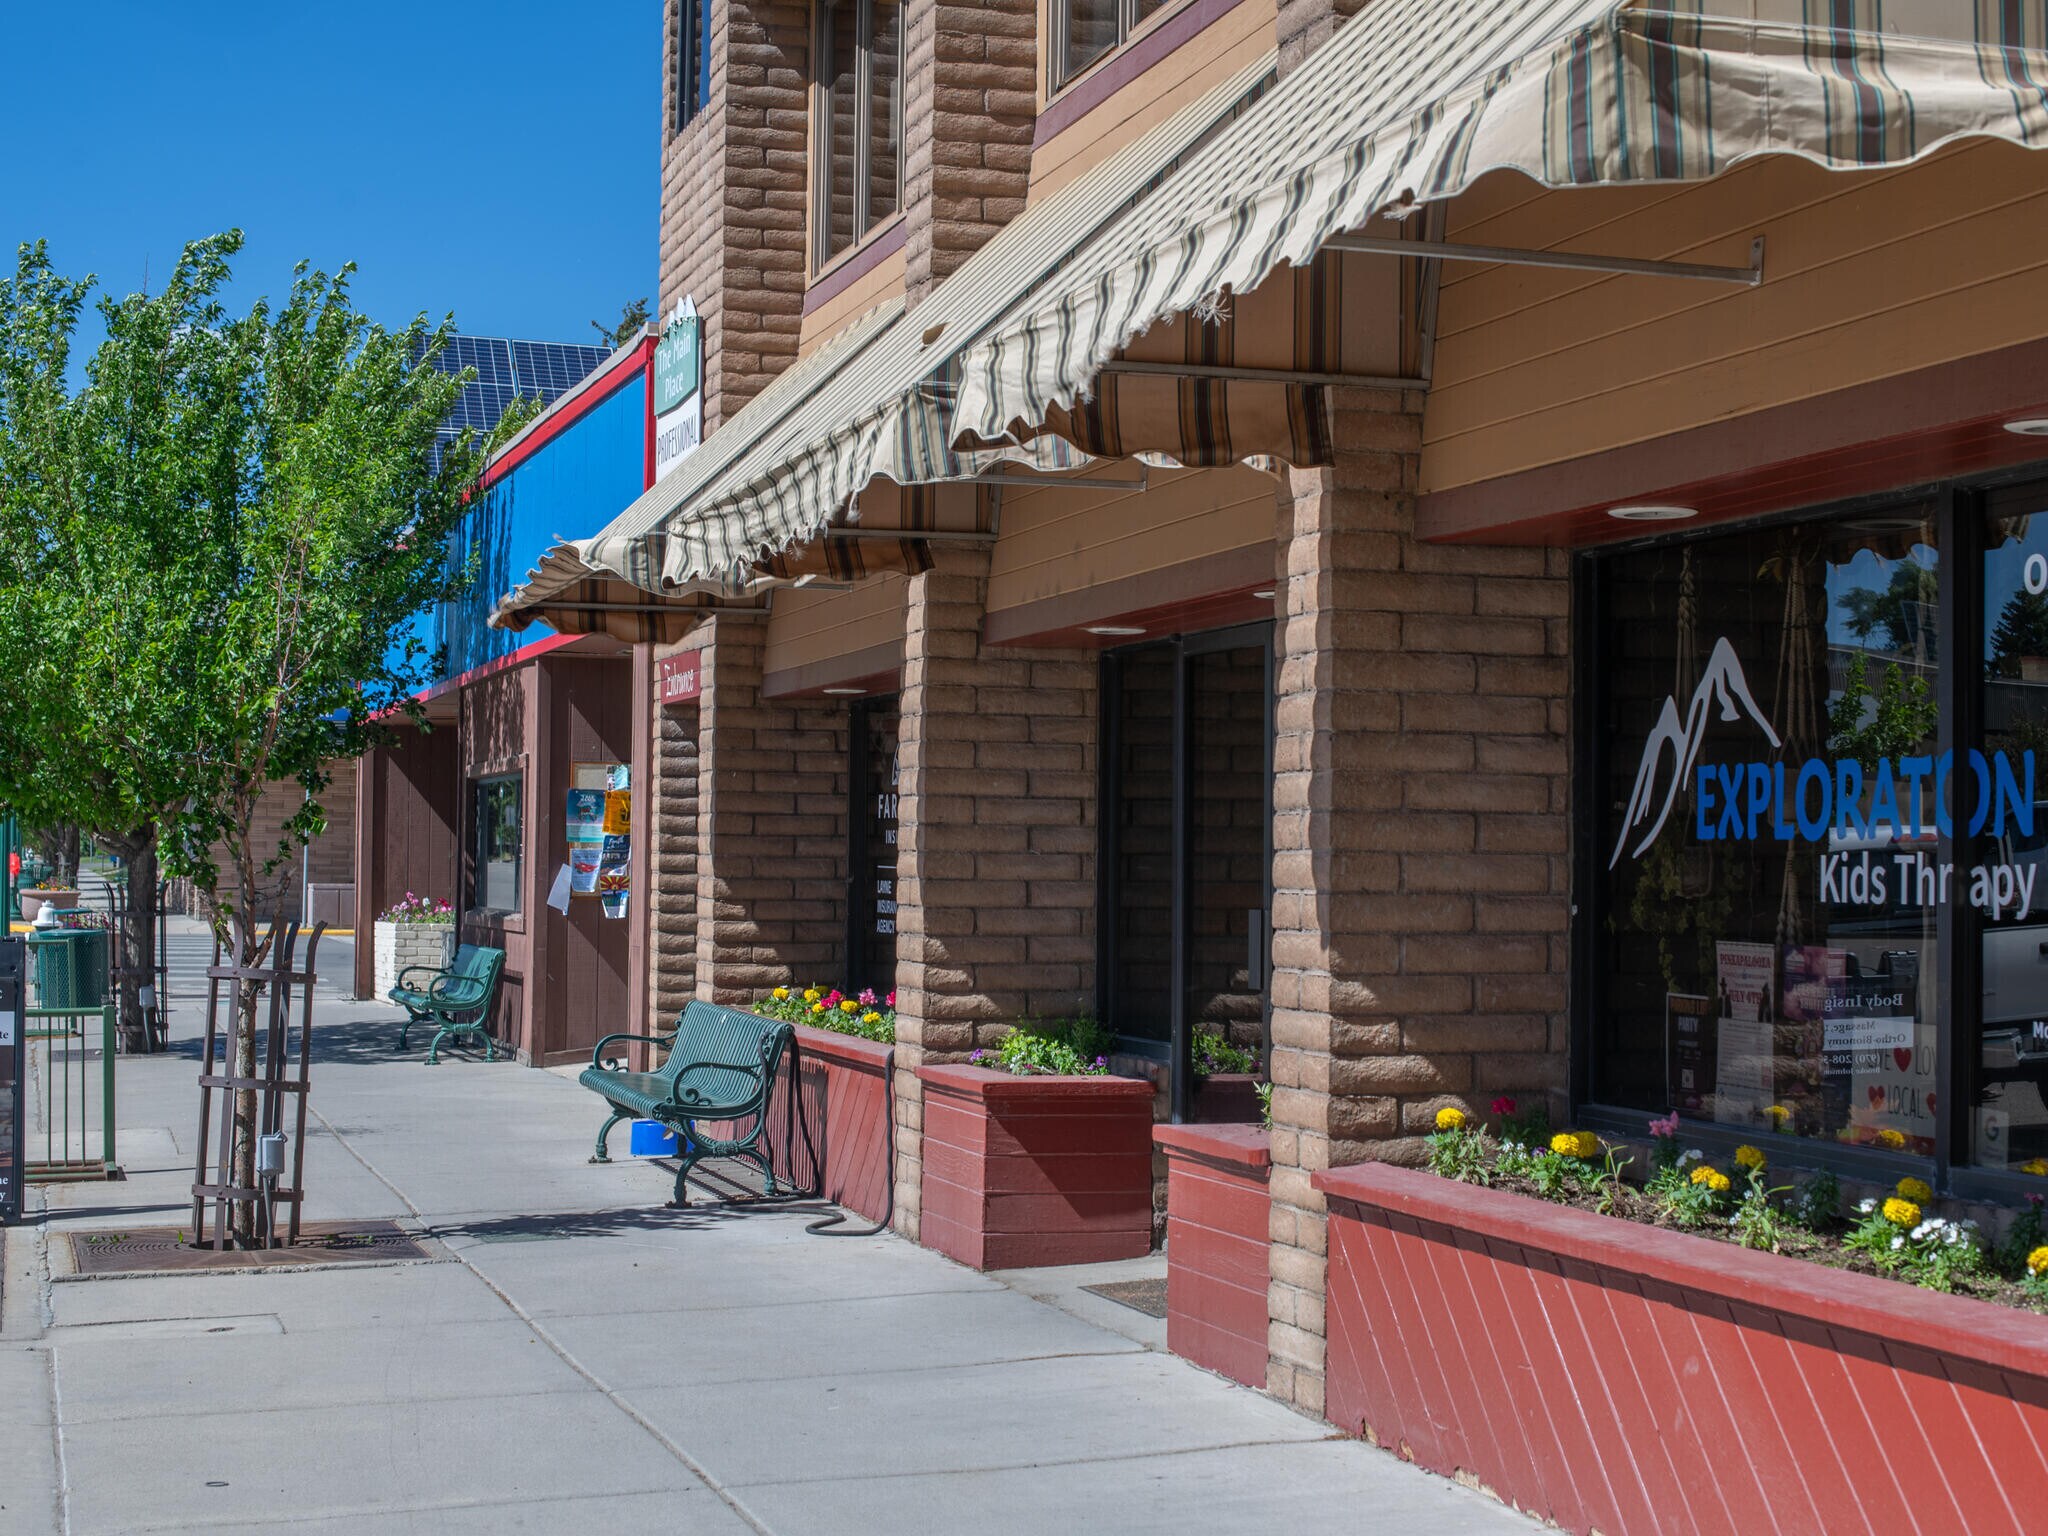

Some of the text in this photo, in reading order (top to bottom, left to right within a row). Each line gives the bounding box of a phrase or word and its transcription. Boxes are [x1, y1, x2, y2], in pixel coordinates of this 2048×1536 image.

[658, 332, 691, 375] The Main
[665, 372, 684, 402] Place
[657, 413, 698, 467] PROFESSIONAL
[1696, 748, 2036, 843] EXPLORATON
[1820, 850, 2038, 921] Kids Thrapy
